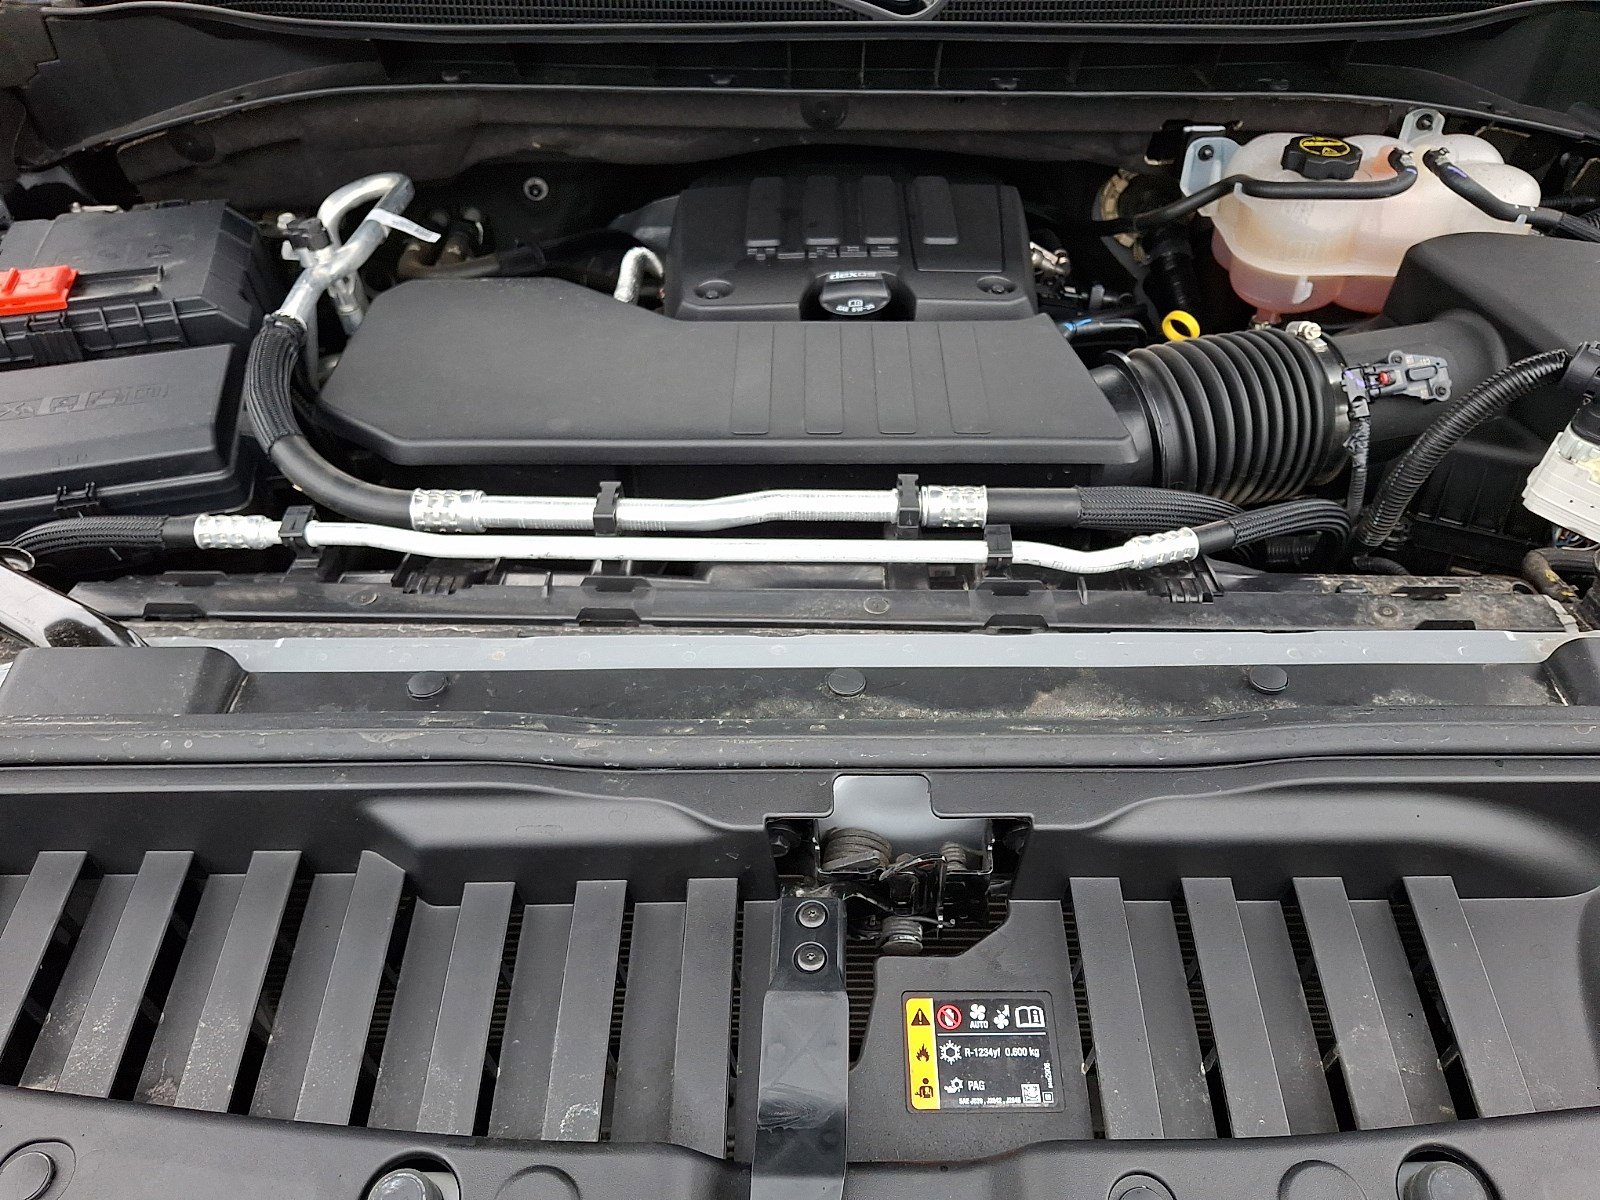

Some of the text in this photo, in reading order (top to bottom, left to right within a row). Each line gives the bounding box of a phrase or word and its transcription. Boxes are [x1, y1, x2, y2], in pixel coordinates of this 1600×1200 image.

[969, 1020, 988, 1029] AUTO
[964, 1046, 1040, 1058] R-1234yf 0.600 kg
[967, 1080, 986, 1091] PAG
